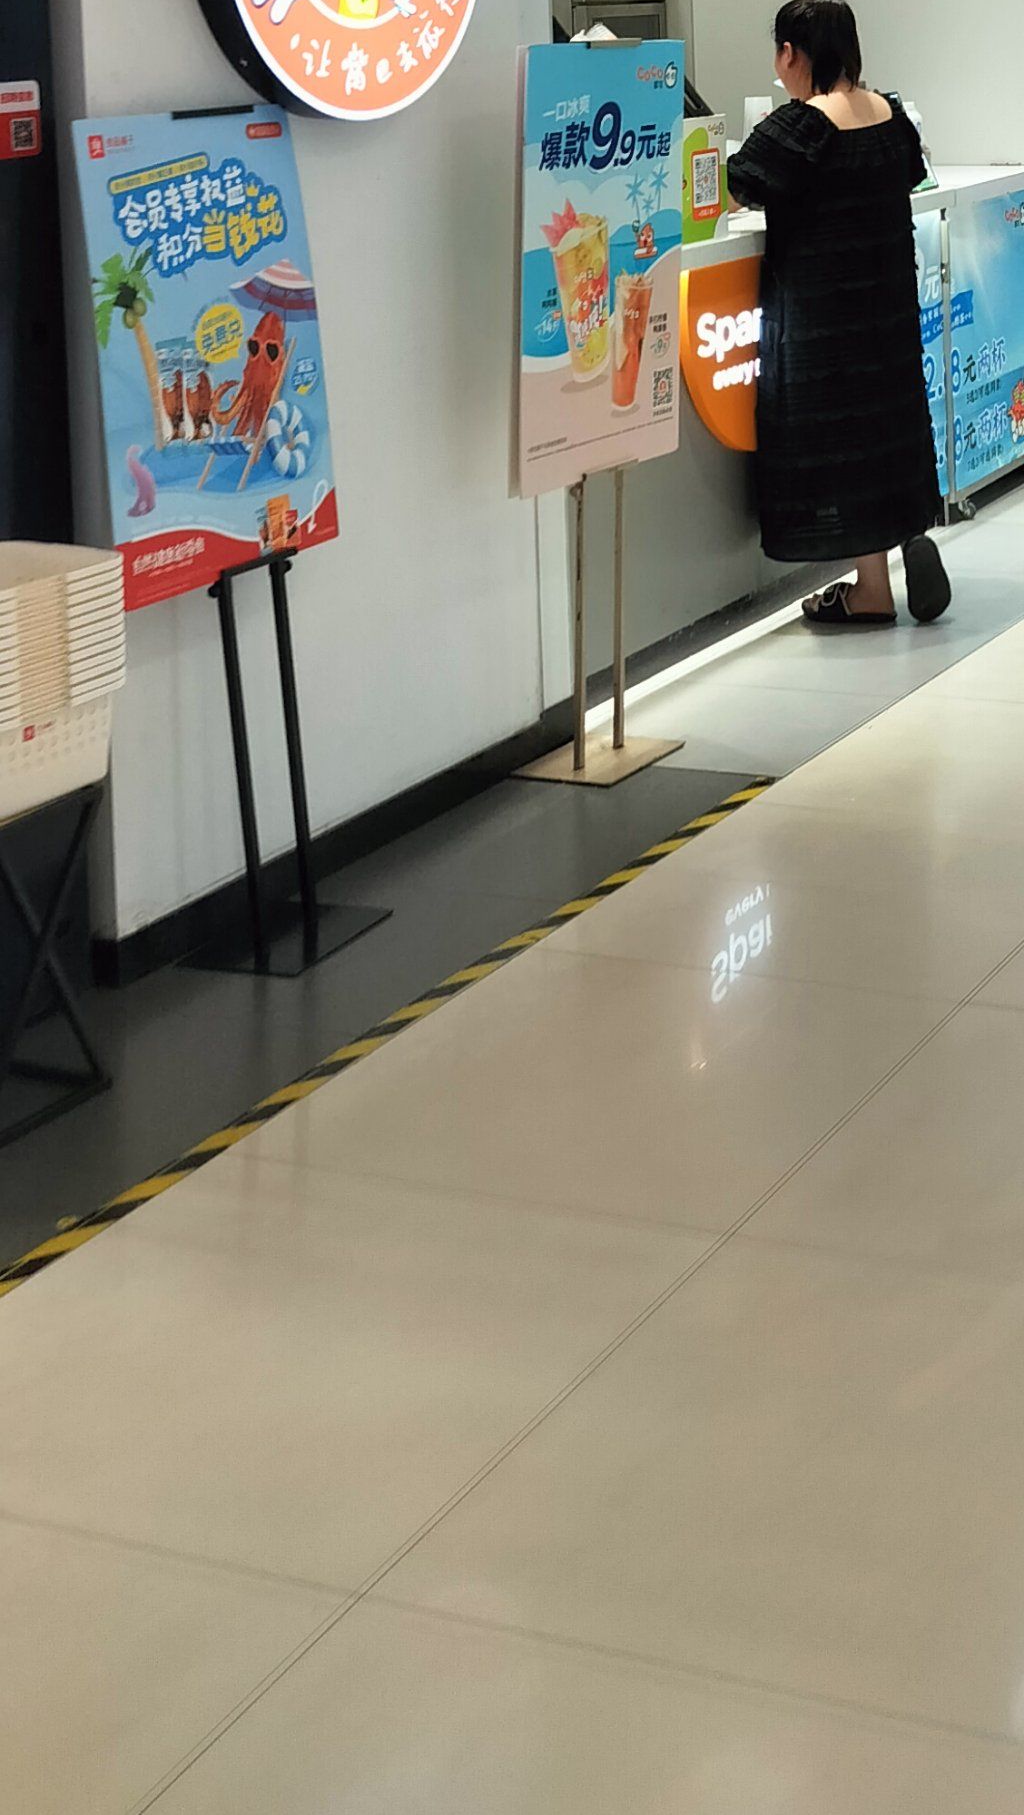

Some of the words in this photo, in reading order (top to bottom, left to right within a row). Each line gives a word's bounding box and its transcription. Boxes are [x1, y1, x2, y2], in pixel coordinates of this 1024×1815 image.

[543, 94, 591, 122] 一口冰爽
[118, 165, 246, 238] 会员专享权益
[157, 192, 284, 271] 积分当钱花
[697, 307, 762, 363] Spar
